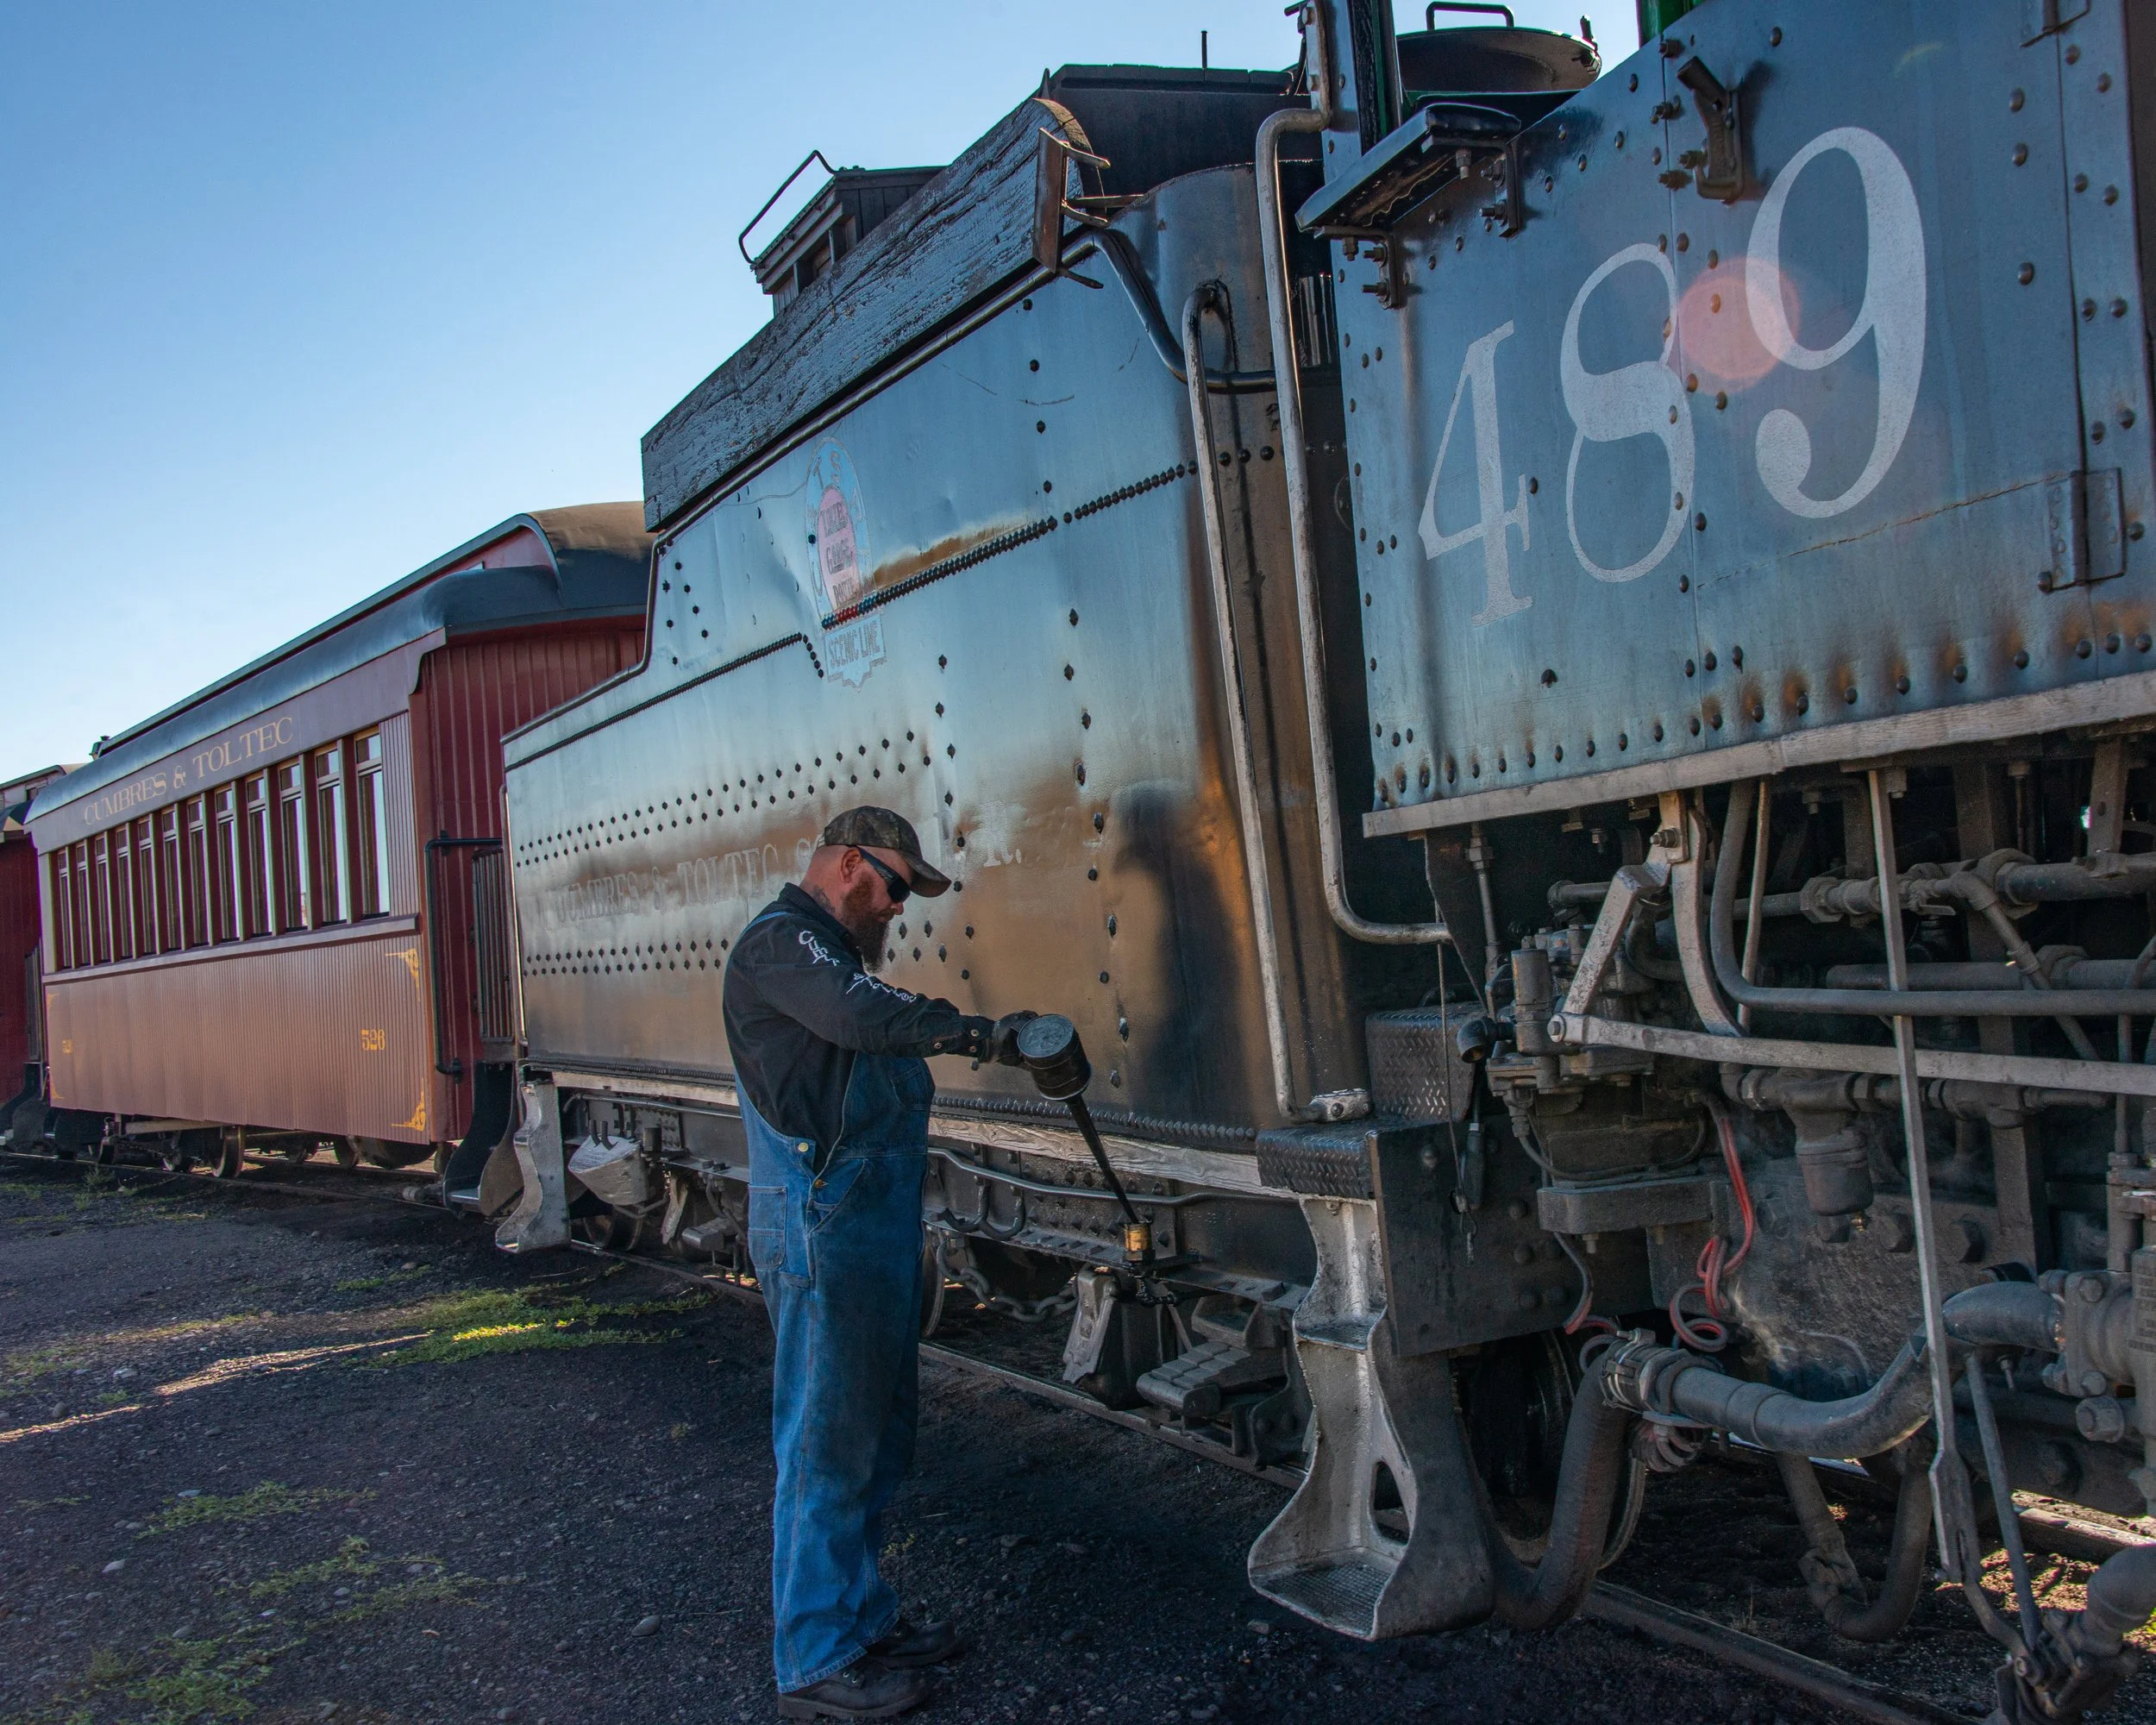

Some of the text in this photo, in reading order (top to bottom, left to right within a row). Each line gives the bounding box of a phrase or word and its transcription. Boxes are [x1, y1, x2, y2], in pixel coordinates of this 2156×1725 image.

[1418, 127, 1927, 626] 489
[84, 717, 293, 826] CUMBRES & TOLTEC
[676, 843, 780, 905] TOLTEC
[360, 1029, 385, 1051] 526
